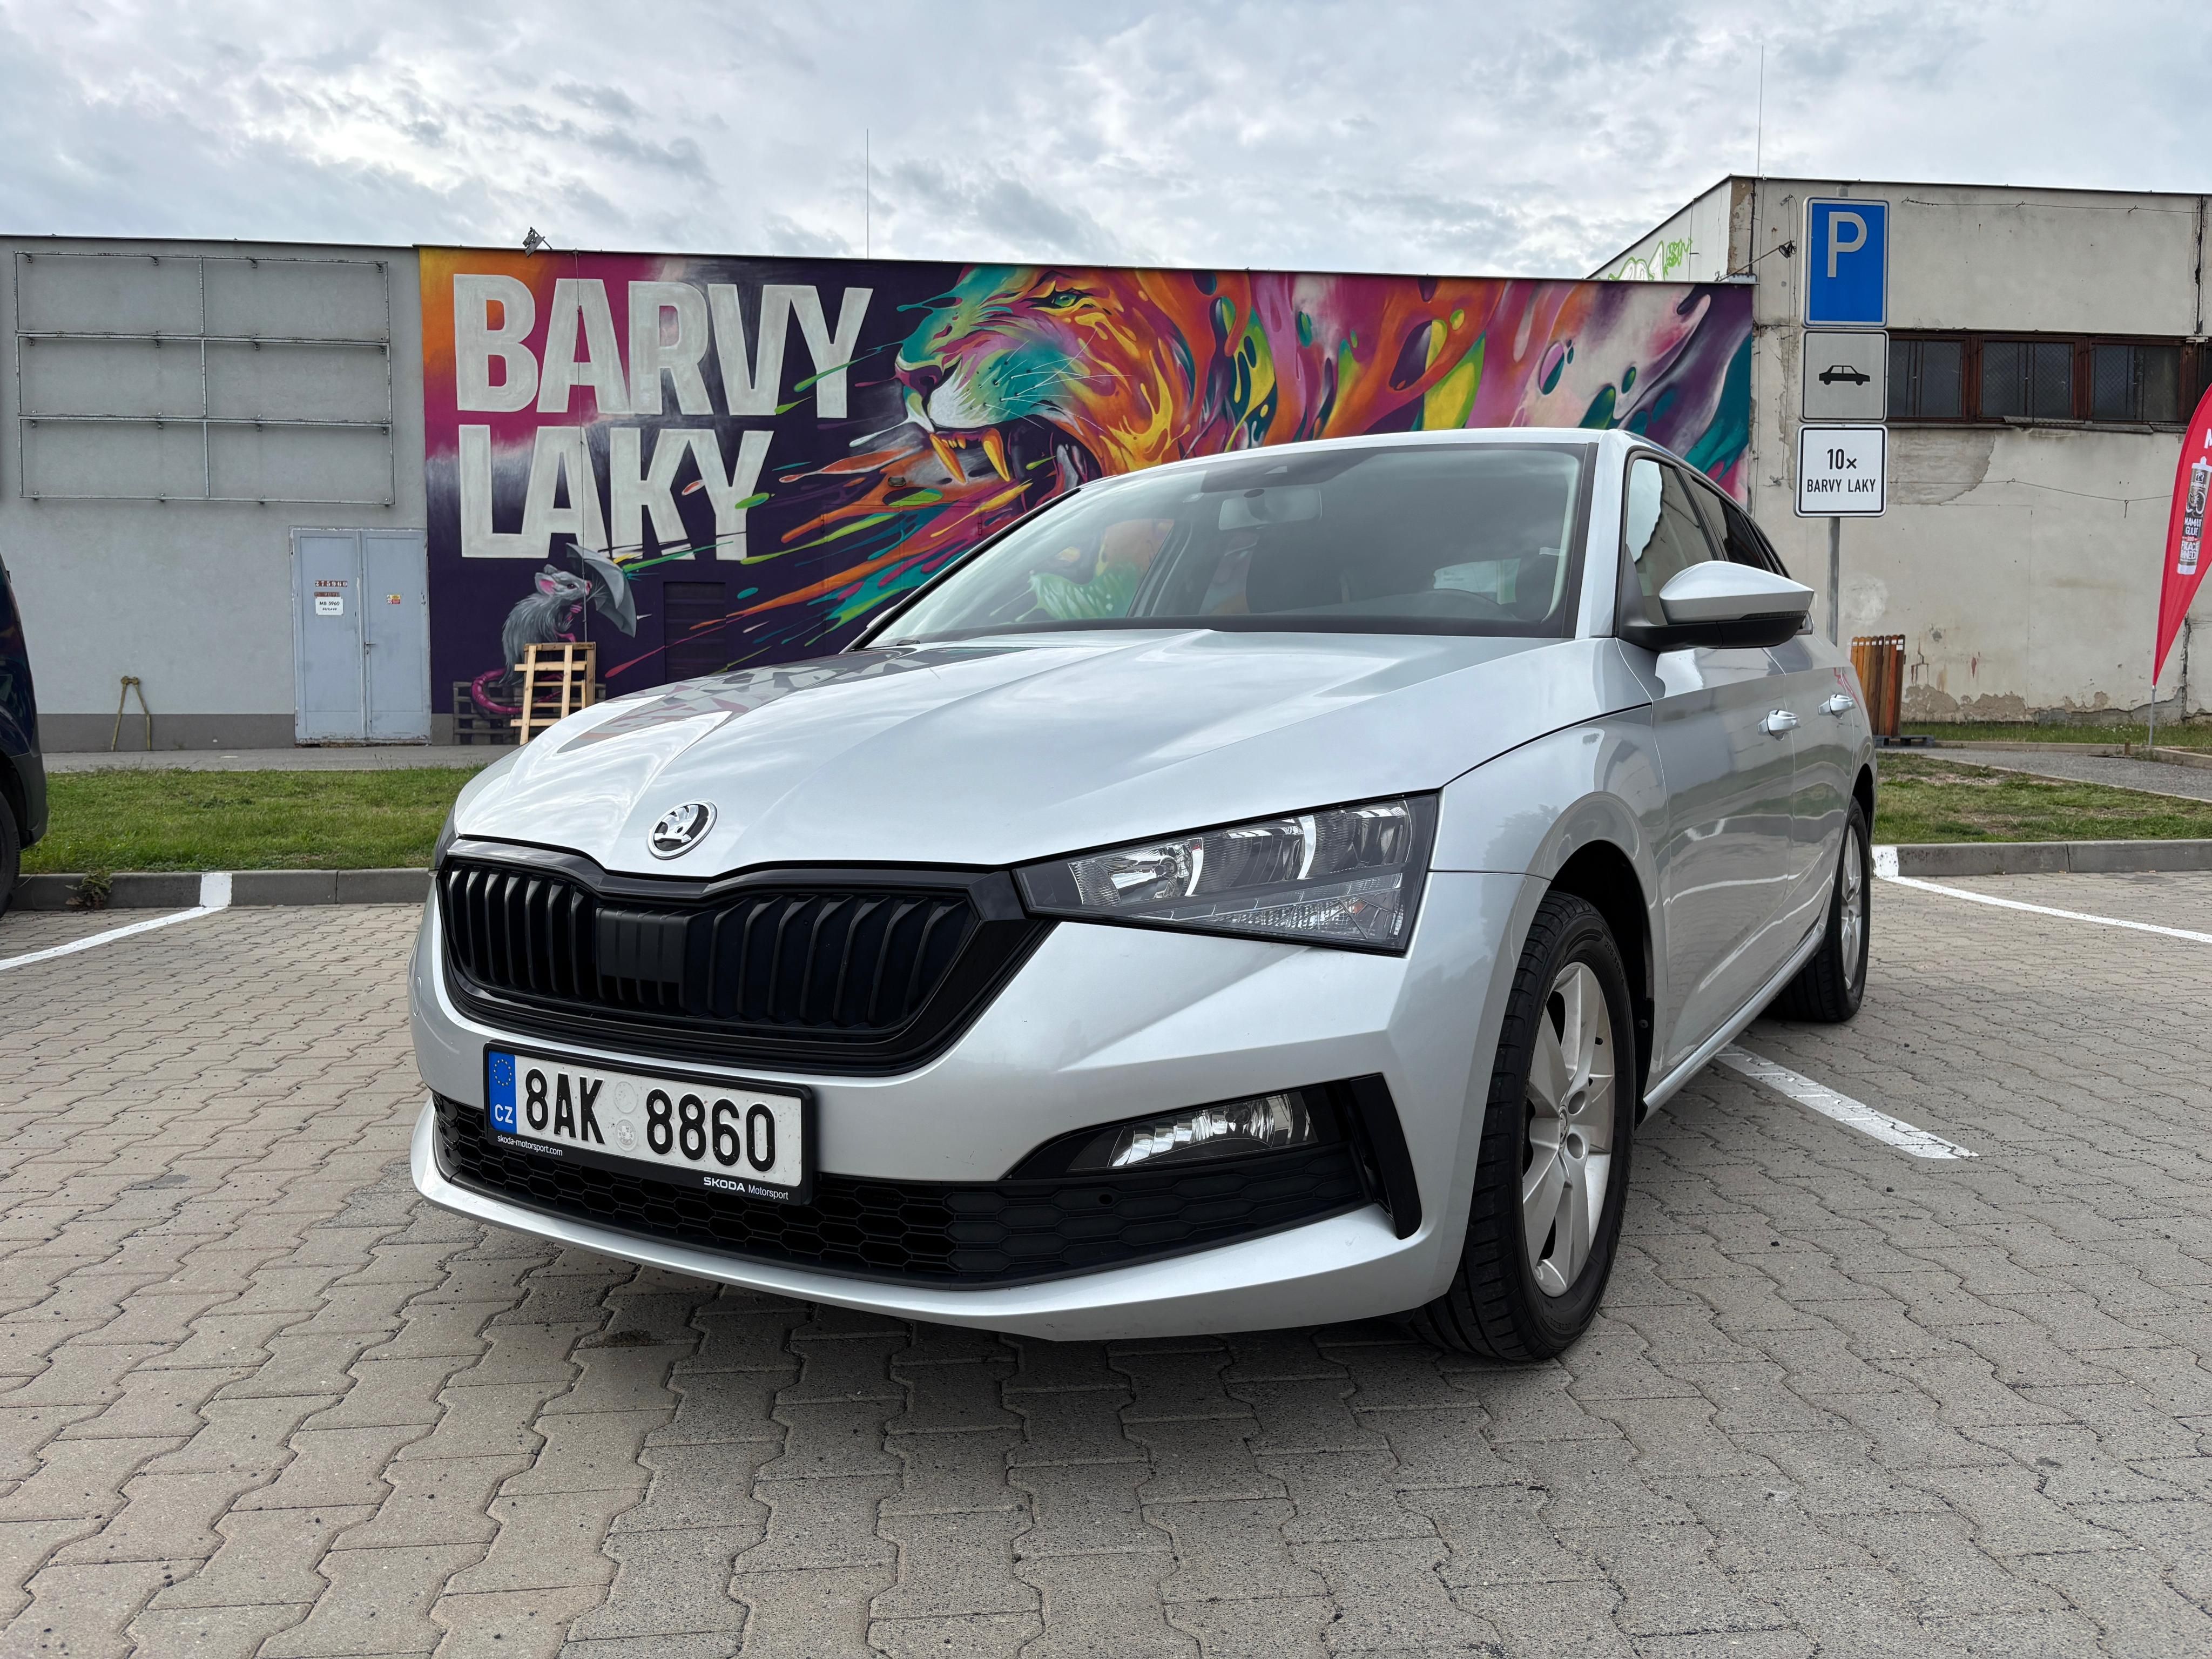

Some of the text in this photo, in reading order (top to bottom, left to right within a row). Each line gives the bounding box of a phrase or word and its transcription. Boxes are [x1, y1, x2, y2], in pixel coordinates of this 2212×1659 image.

[1827, 211, 1867, 278] P
[453, 274, 874, 419] BARVY
[458, 424, 774, 561] LAKY
[1806, 479, 1876, 493] BARVY LAKY
[494, 1103, 513, 1124] CZ
[525, 1068, 775, 1172] 8AK 8860
[497, 1134, 563, 1156] skoda-motorsport.com
[748, 1184, 788, 1200] Motorsport
